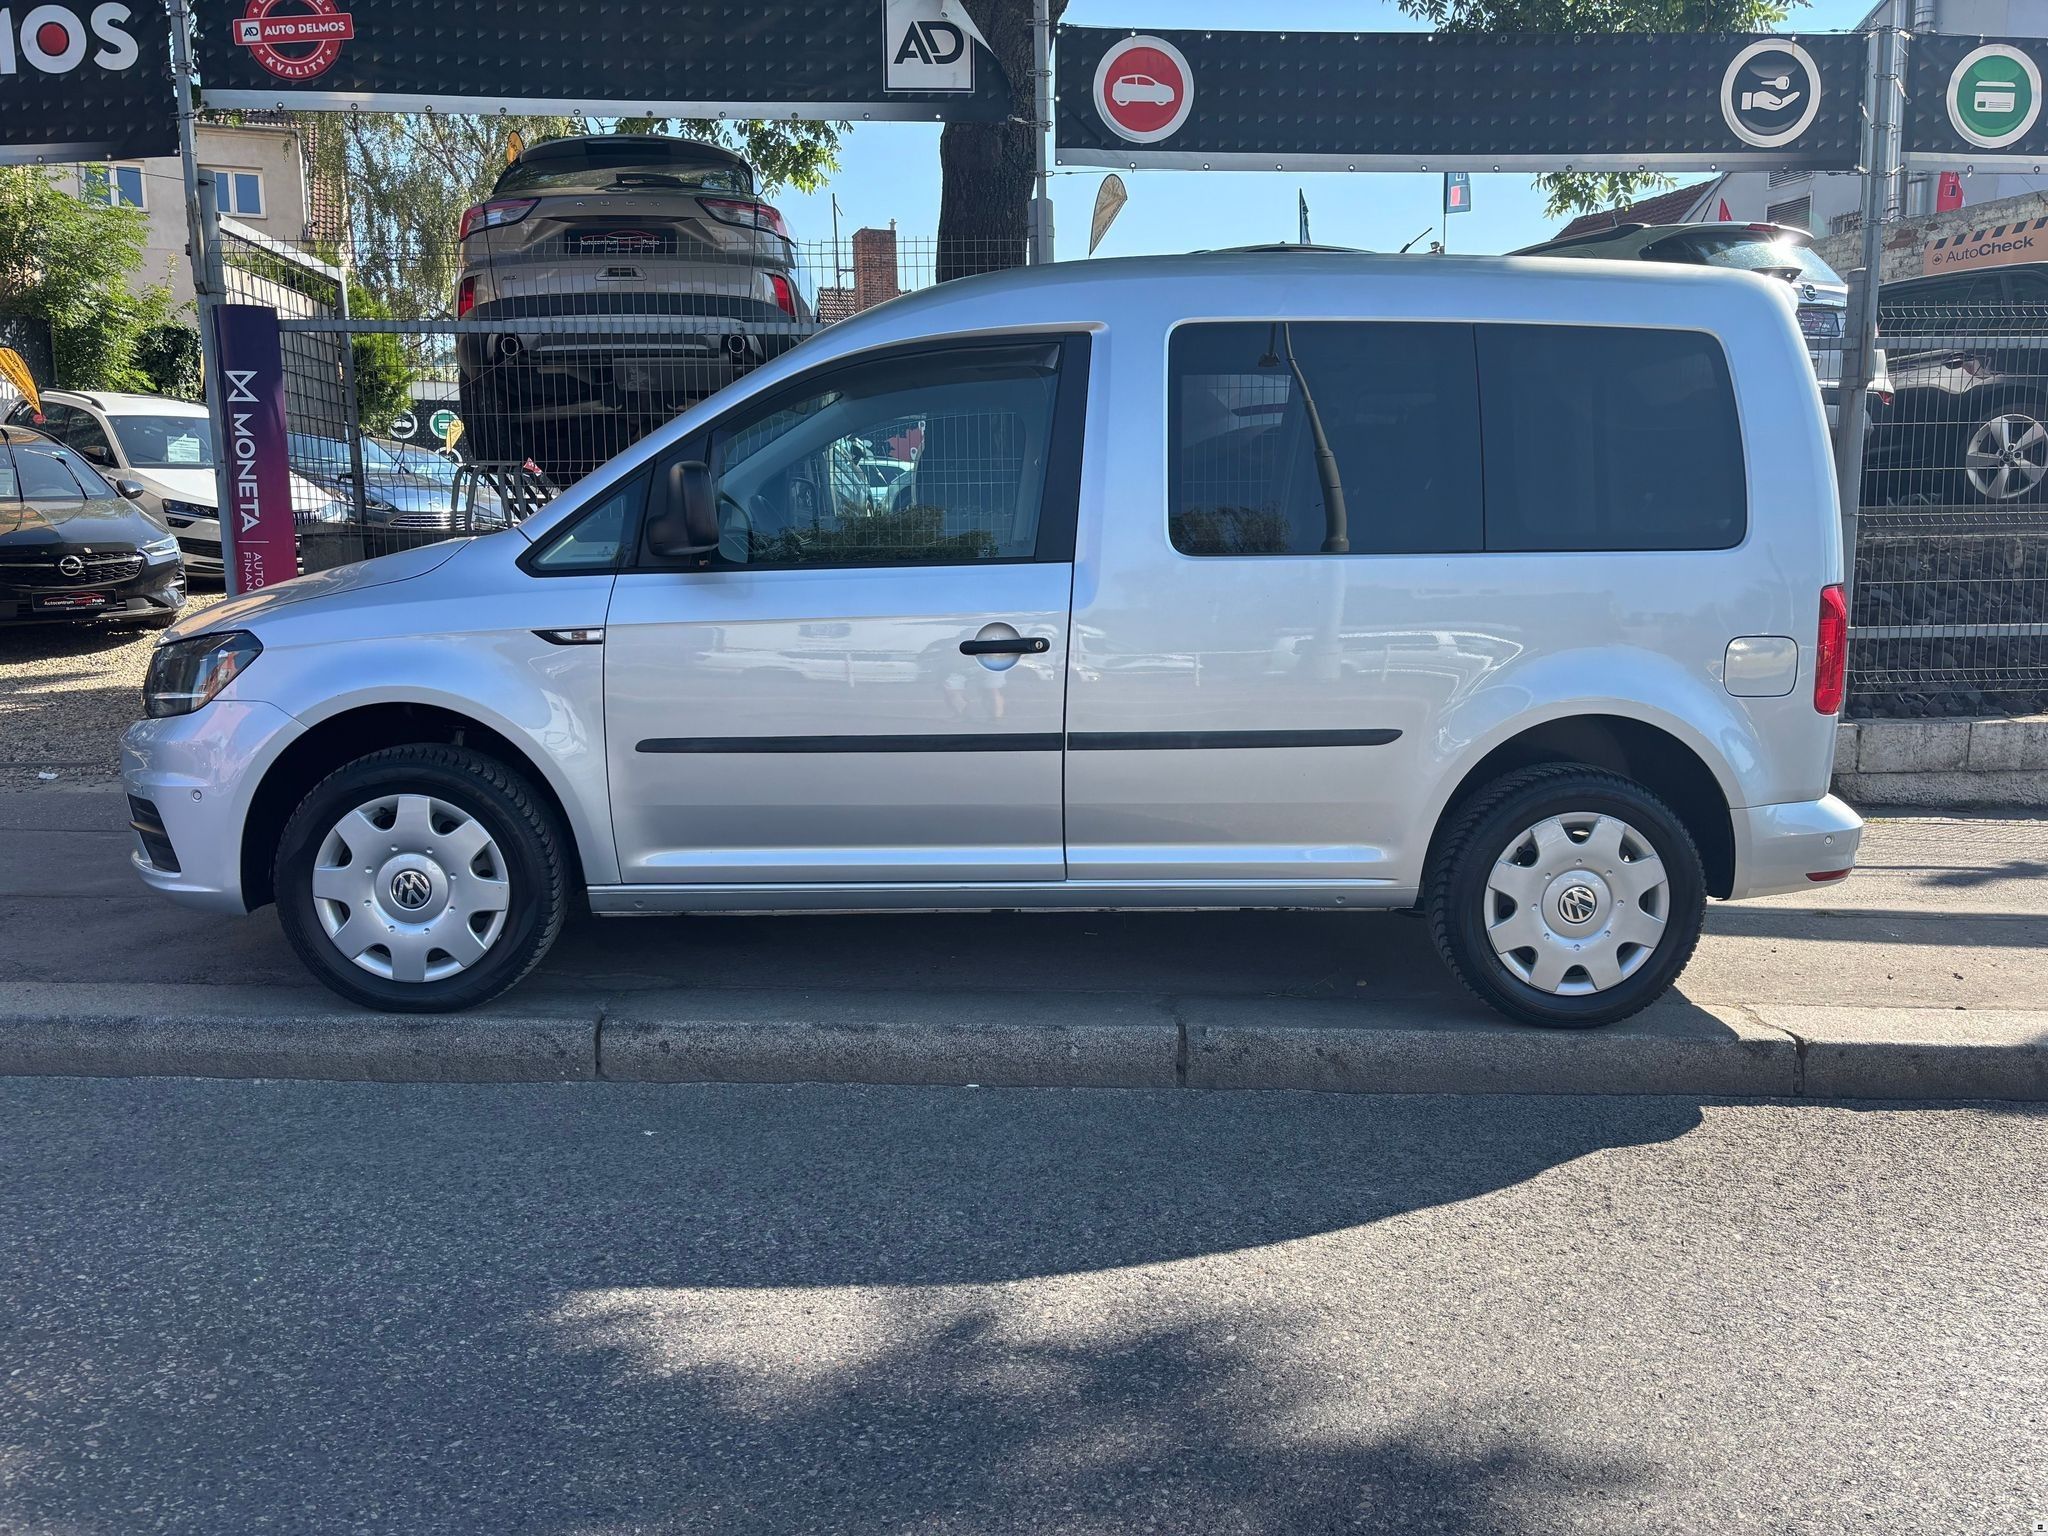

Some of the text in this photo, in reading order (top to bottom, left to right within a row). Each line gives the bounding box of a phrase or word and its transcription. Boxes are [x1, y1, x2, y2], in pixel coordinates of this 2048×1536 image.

[264, 21, 346, 36] AUTO DELMOS
[893, 20, 965, 65] AD
[265, 56, 326, 76] KVALITY
[1945, 235, 2035, 263] AutoCheck
[233, 413, 261, 533] MONETA
[243, 551, 254, 591] FINAN
[253, 552, 265, 587] AUTO
